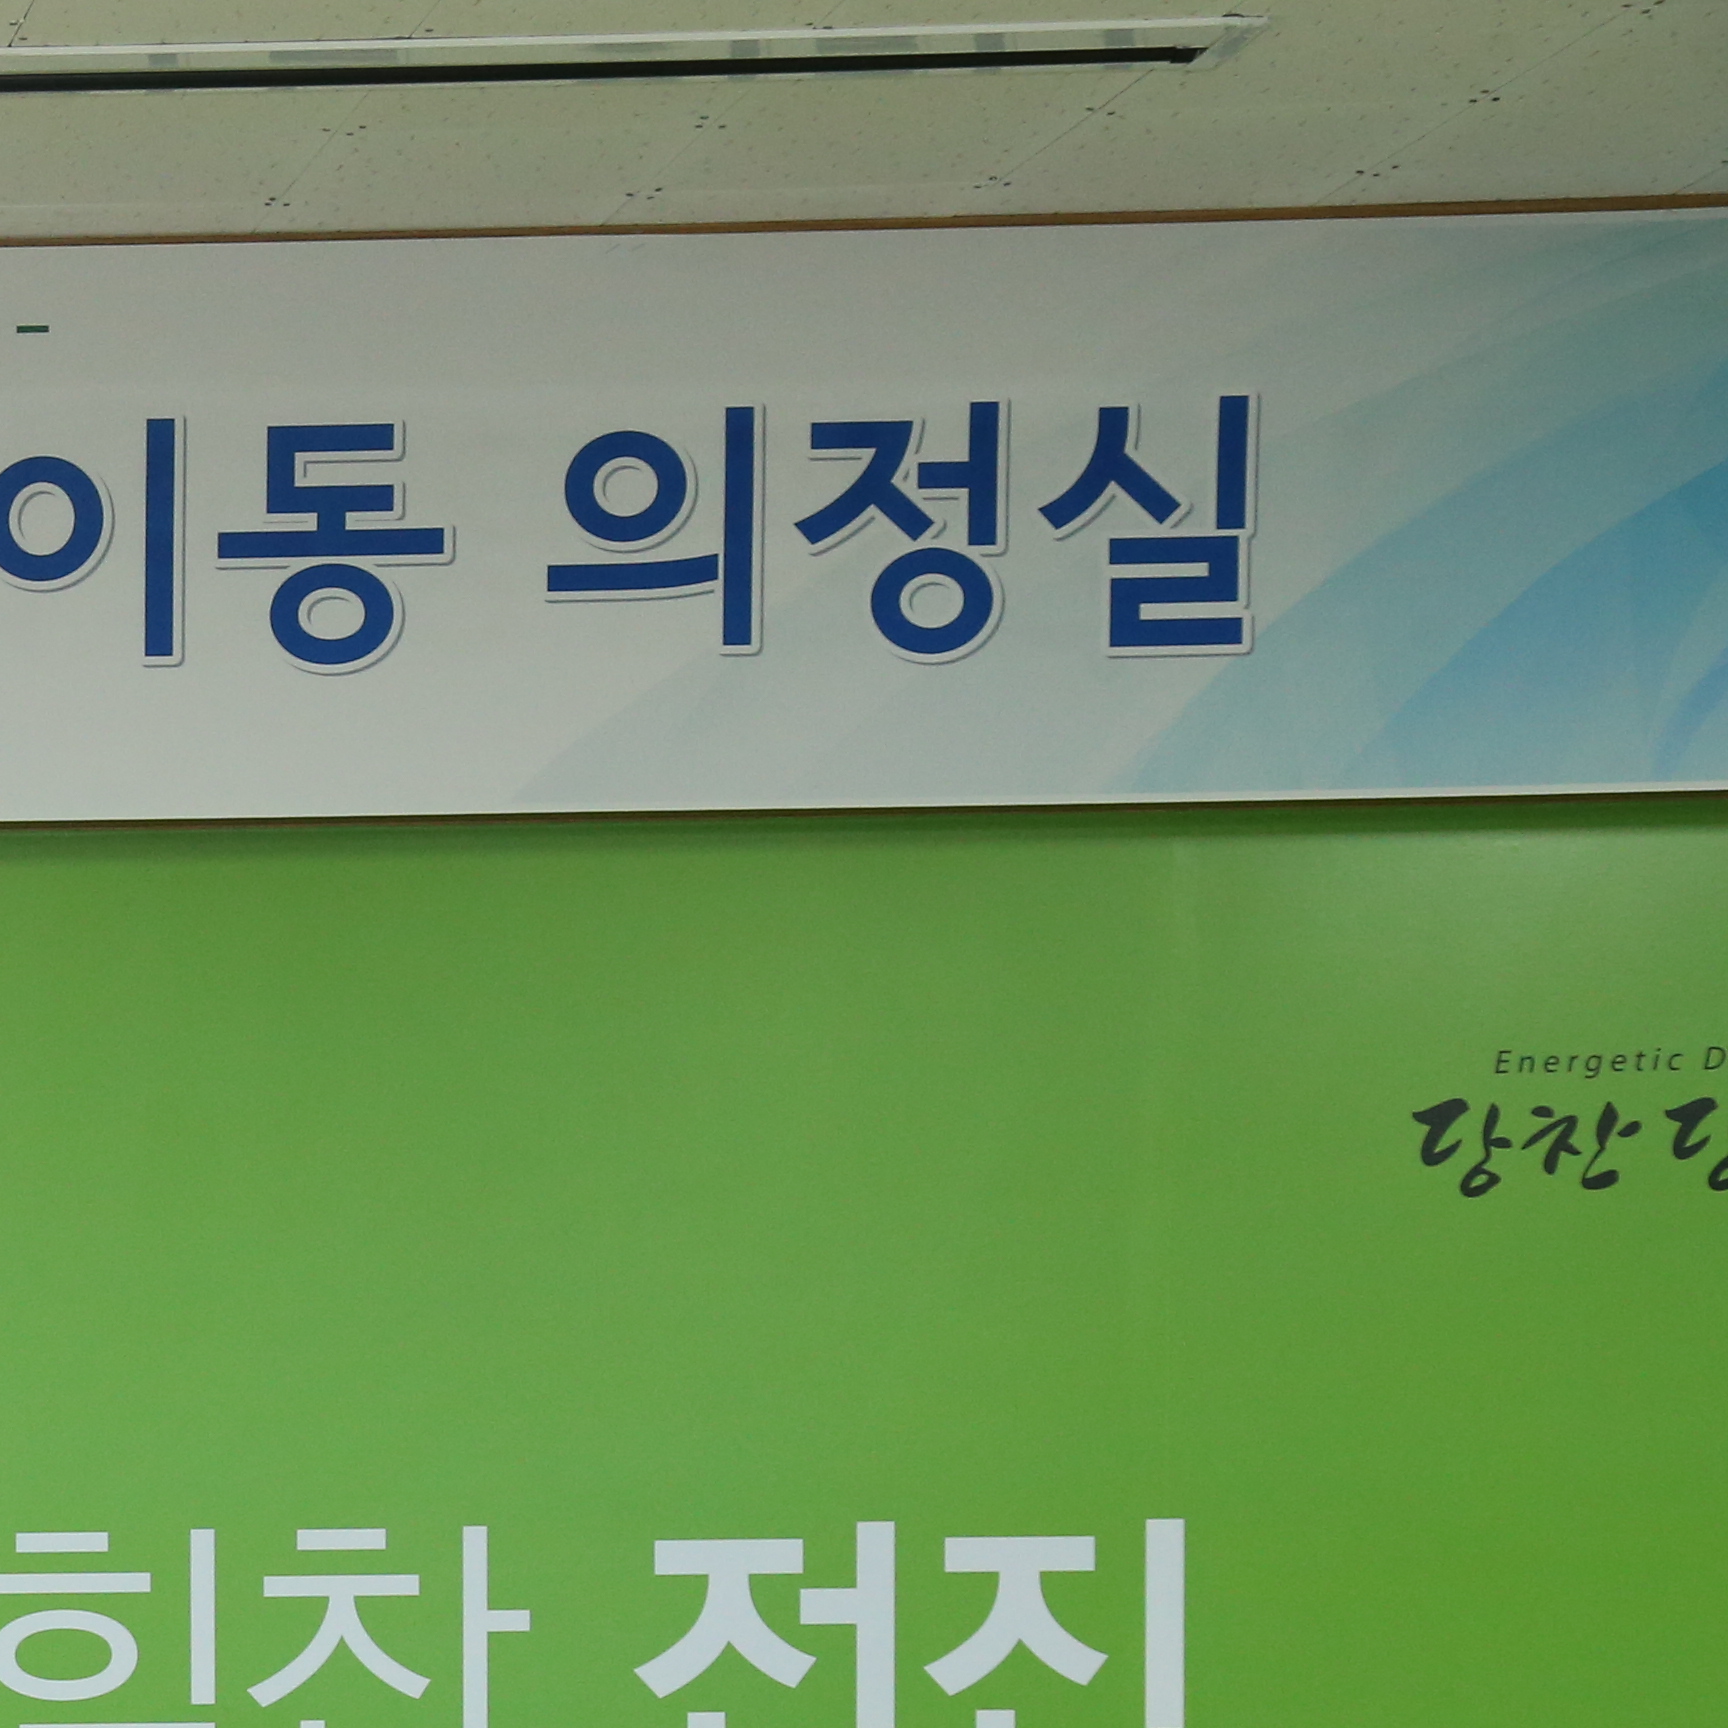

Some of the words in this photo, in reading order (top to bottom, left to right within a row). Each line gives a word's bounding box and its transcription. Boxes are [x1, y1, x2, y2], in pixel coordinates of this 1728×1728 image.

[545, 394, 1254, 662] 의정실
[1494, 1047, 1684, 1079] Energetic
[1412, 1097, 1643, 1198] 당찬
